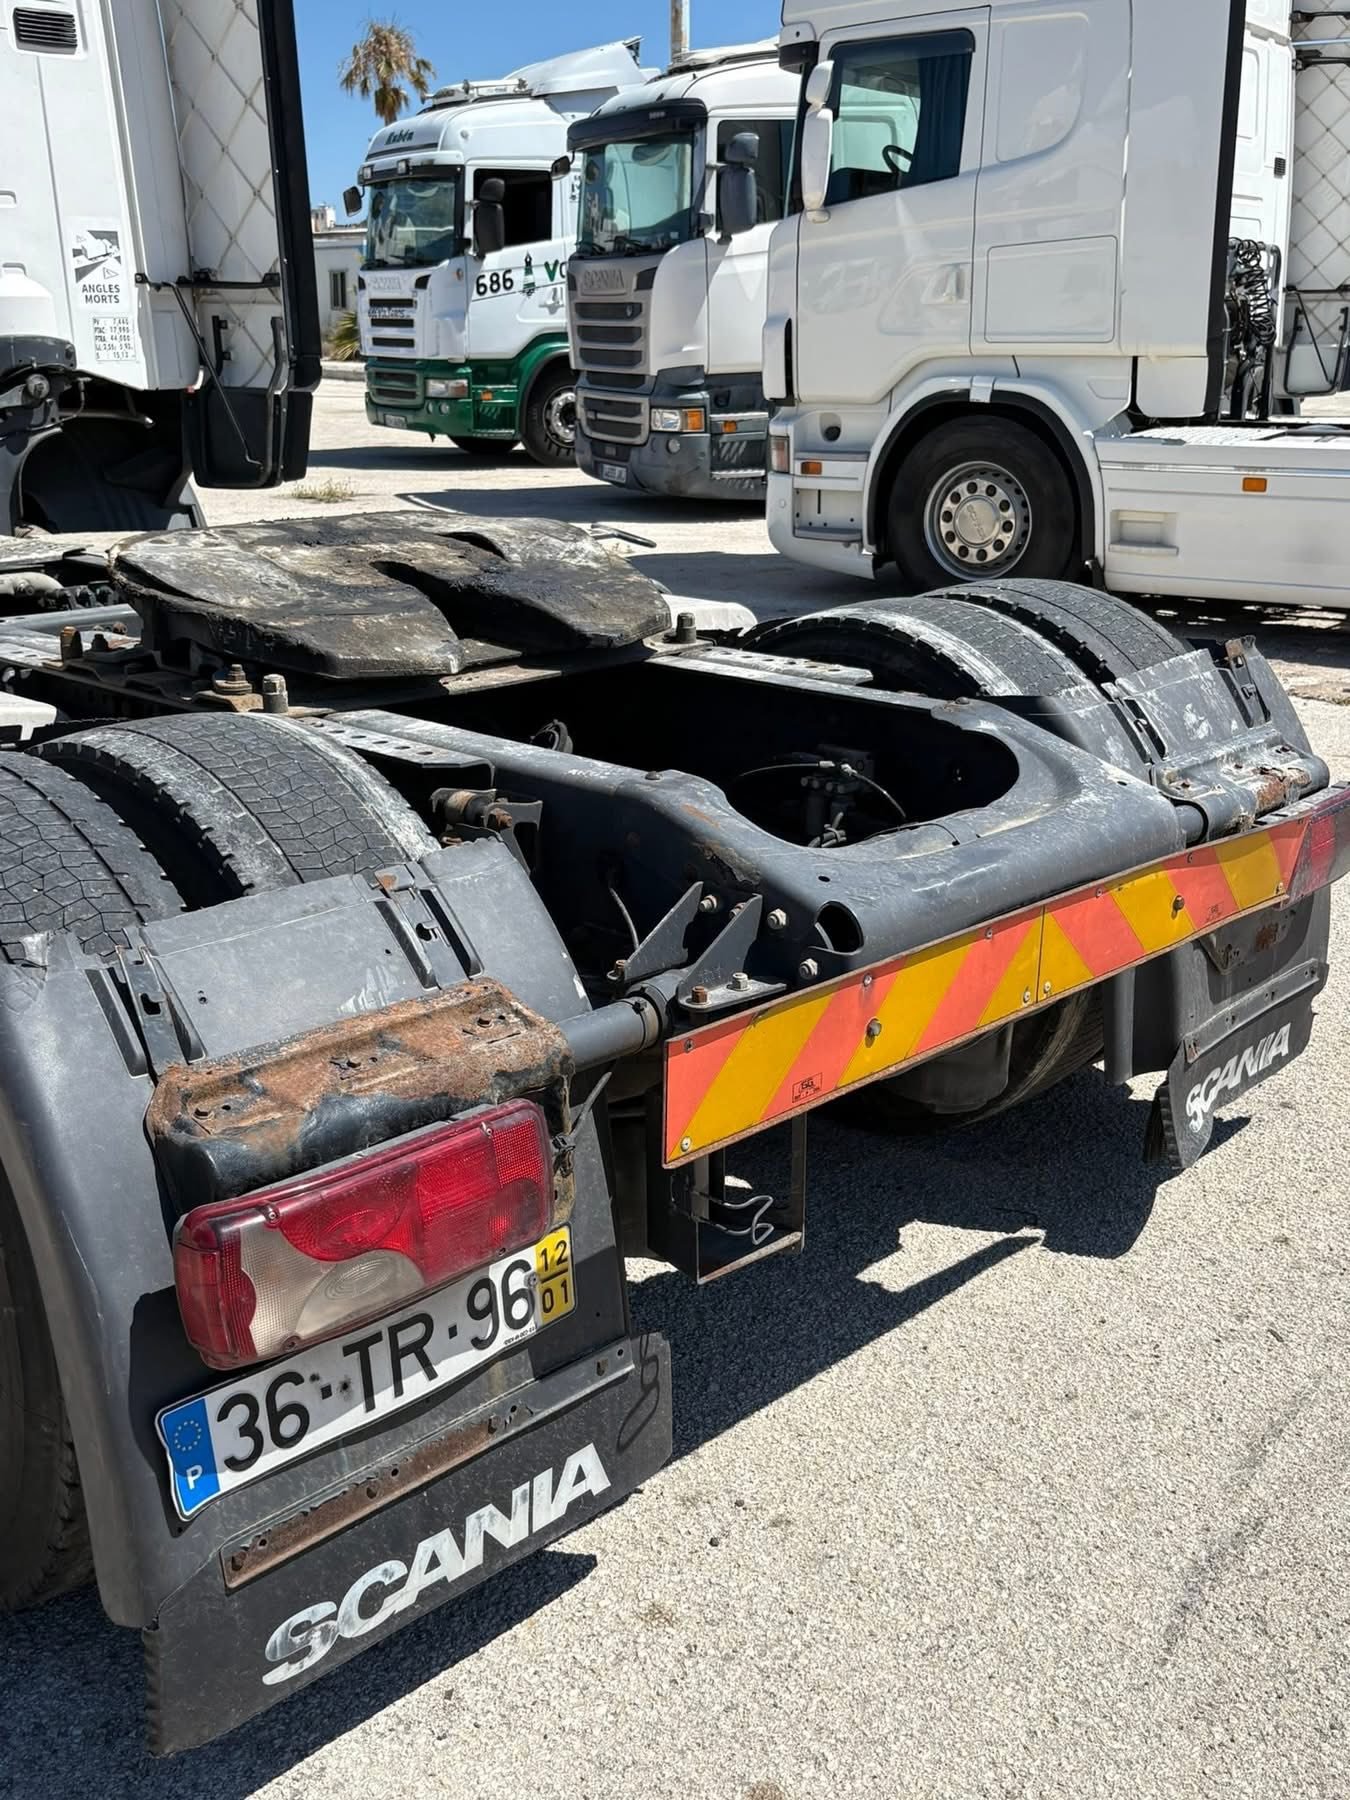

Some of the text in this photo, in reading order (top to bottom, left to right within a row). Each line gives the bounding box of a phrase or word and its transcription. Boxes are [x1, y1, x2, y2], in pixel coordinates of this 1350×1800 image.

[82, 284, 121, 293] ANGLES
[475, 268, 514, 297] 686
[85, 294, 120, 304] MORTS
[1186, 1022, 1292, 1133] SCANIA
[540, 1239, 569, 1272] 12
[542, 1279, 569, 1314] 01
[186, 1464, 203, 1490] P
[262, 1442, 612, 1686] SCANIA
